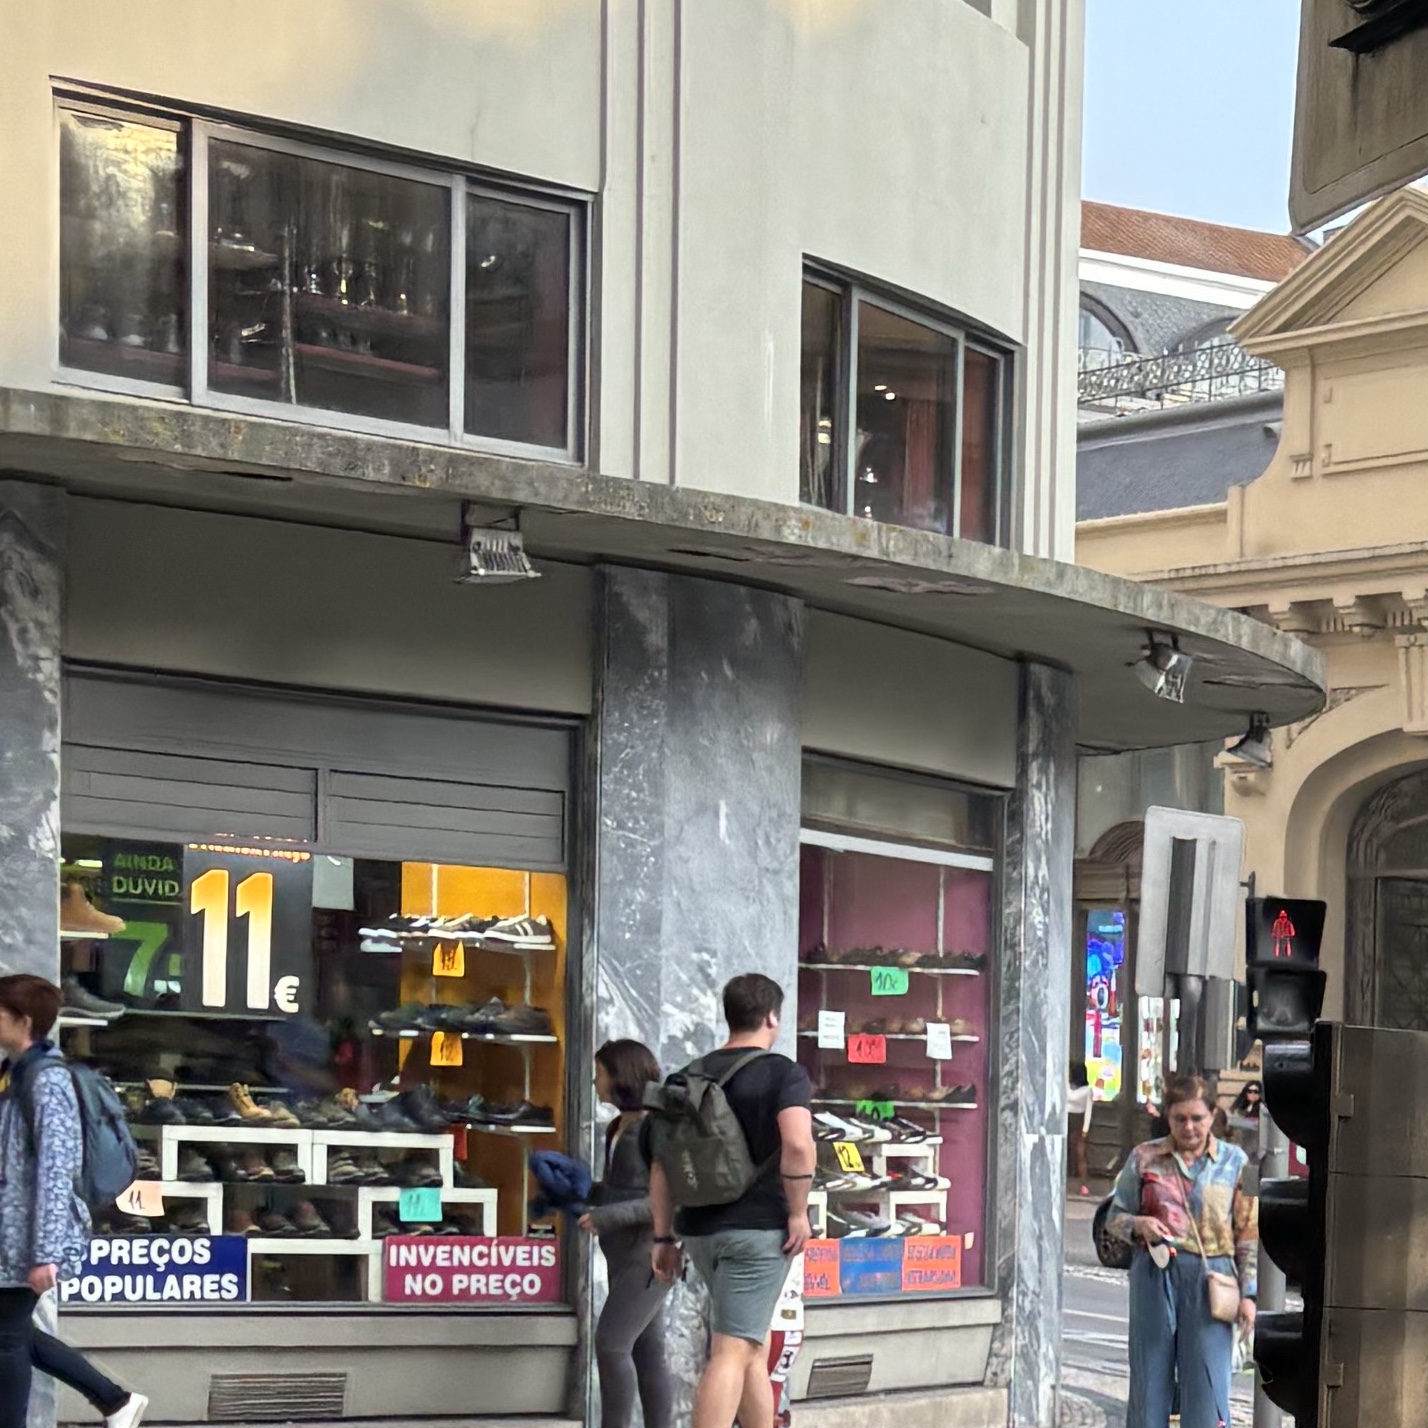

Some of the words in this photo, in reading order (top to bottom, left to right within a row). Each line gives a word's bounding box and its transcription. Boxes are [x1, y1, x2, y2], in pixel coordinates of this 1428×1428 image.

[112, 876, 181, 898] DUVID
[89, 1237, 212, 1273] PREÇOS
[389, 1238, 556, 1267] INVENCÍVEIS
[60, 1272, 239, 1302] POPULARES
[404, 1273, 443, 1295] NO
[452, 1273, 542, 1300] PREÇO
